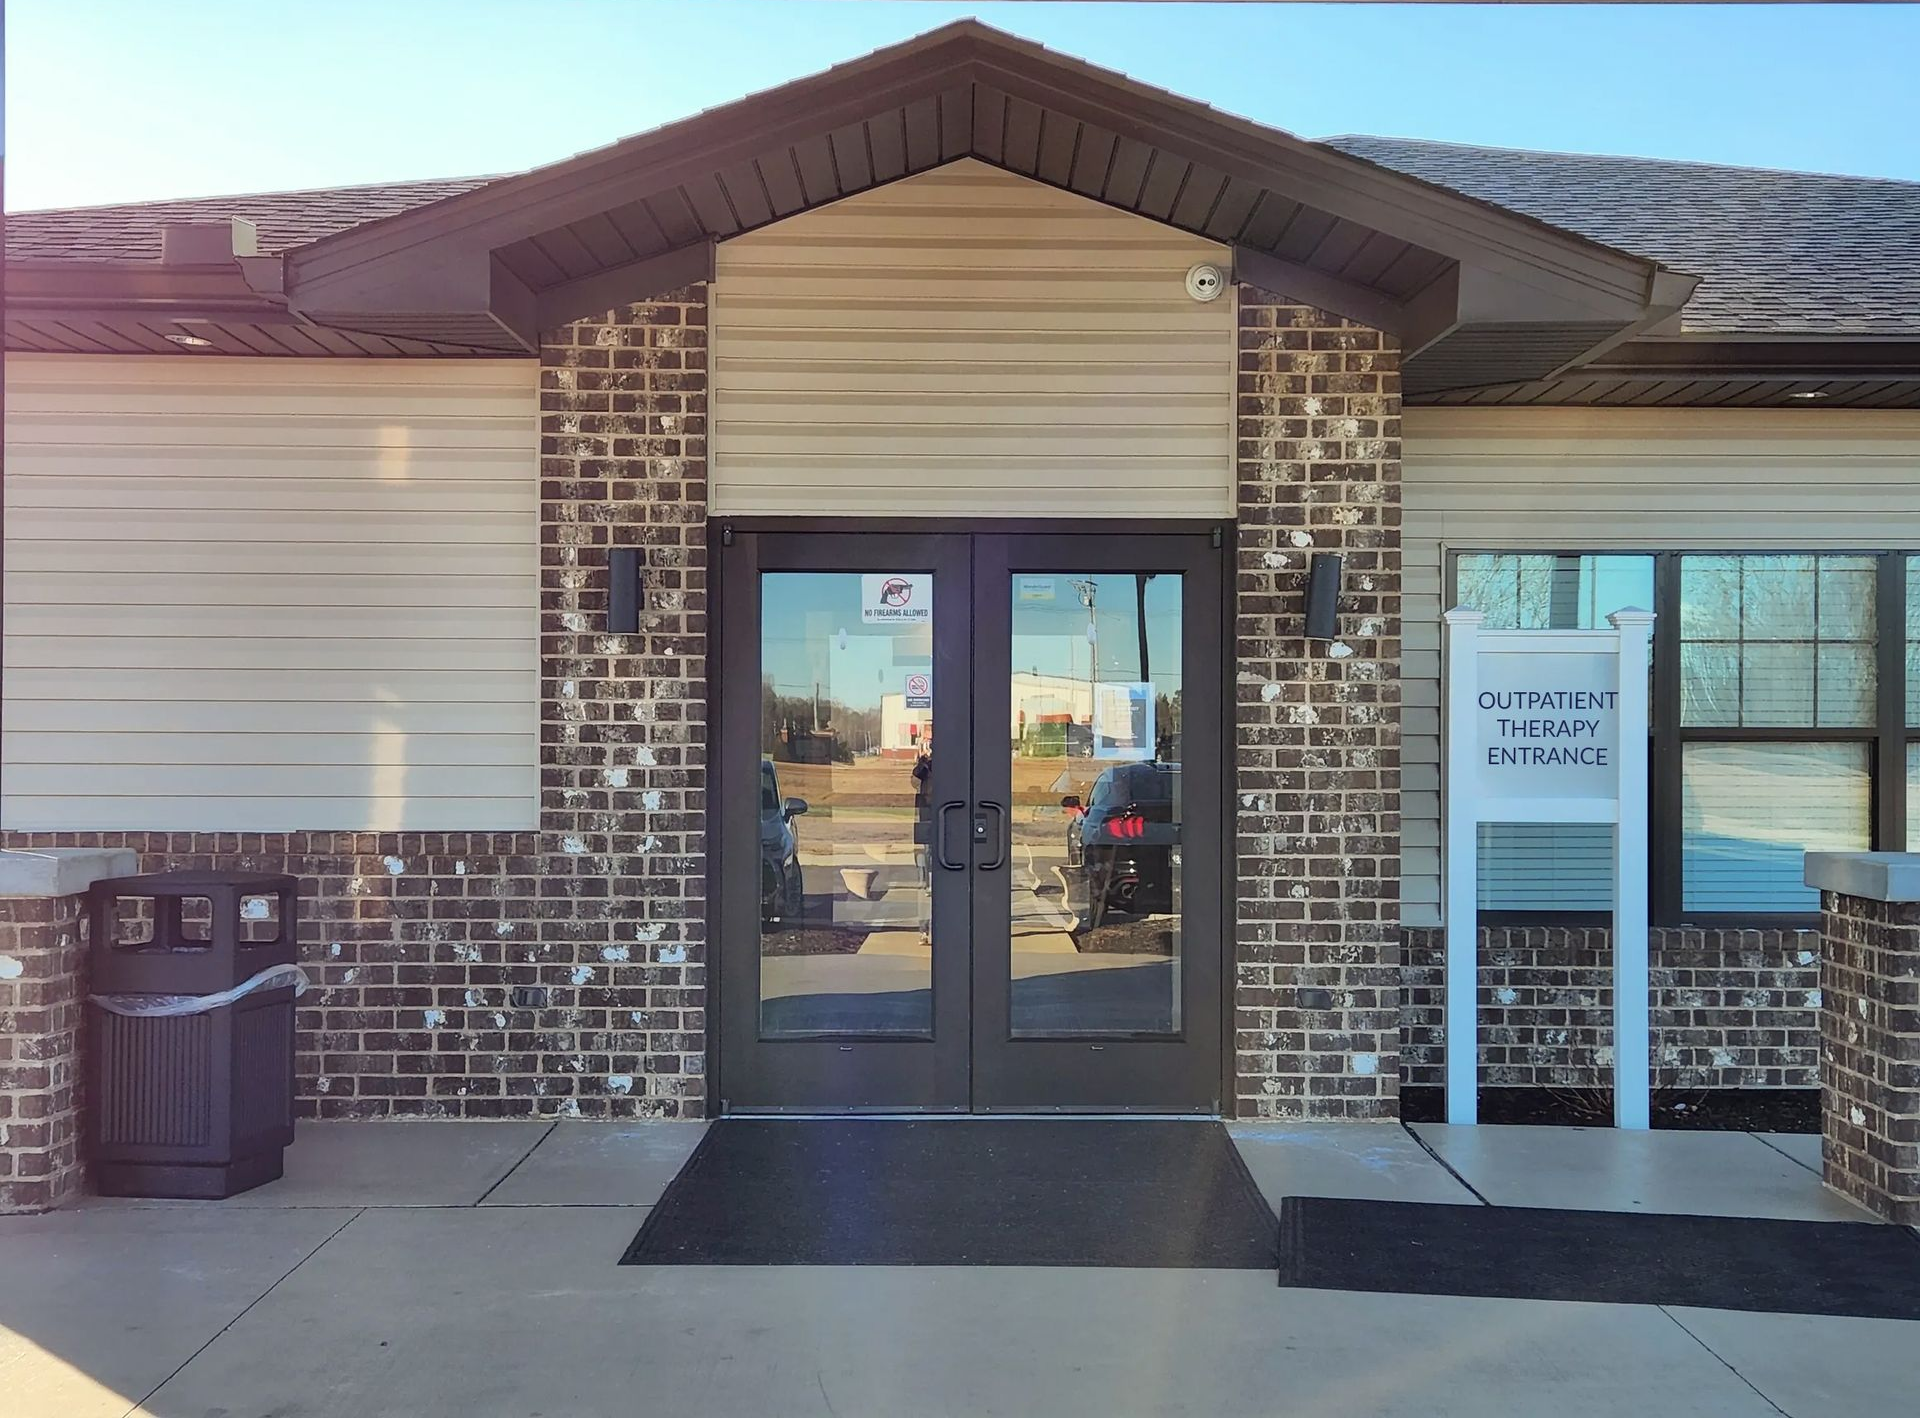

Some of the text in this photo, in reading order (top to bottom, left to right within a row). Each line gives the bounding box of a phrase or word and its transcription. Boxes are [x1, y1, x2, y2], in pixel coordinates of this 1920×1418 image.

[864, 609, 928, 617] NO FIREARMS ALLOWED
[1478, 691, 1619, 710] OUTPATIENT
[1496, 719, 1600, 738] THERAPY
[1488, 747, 1608, 766] ENTRANCE
